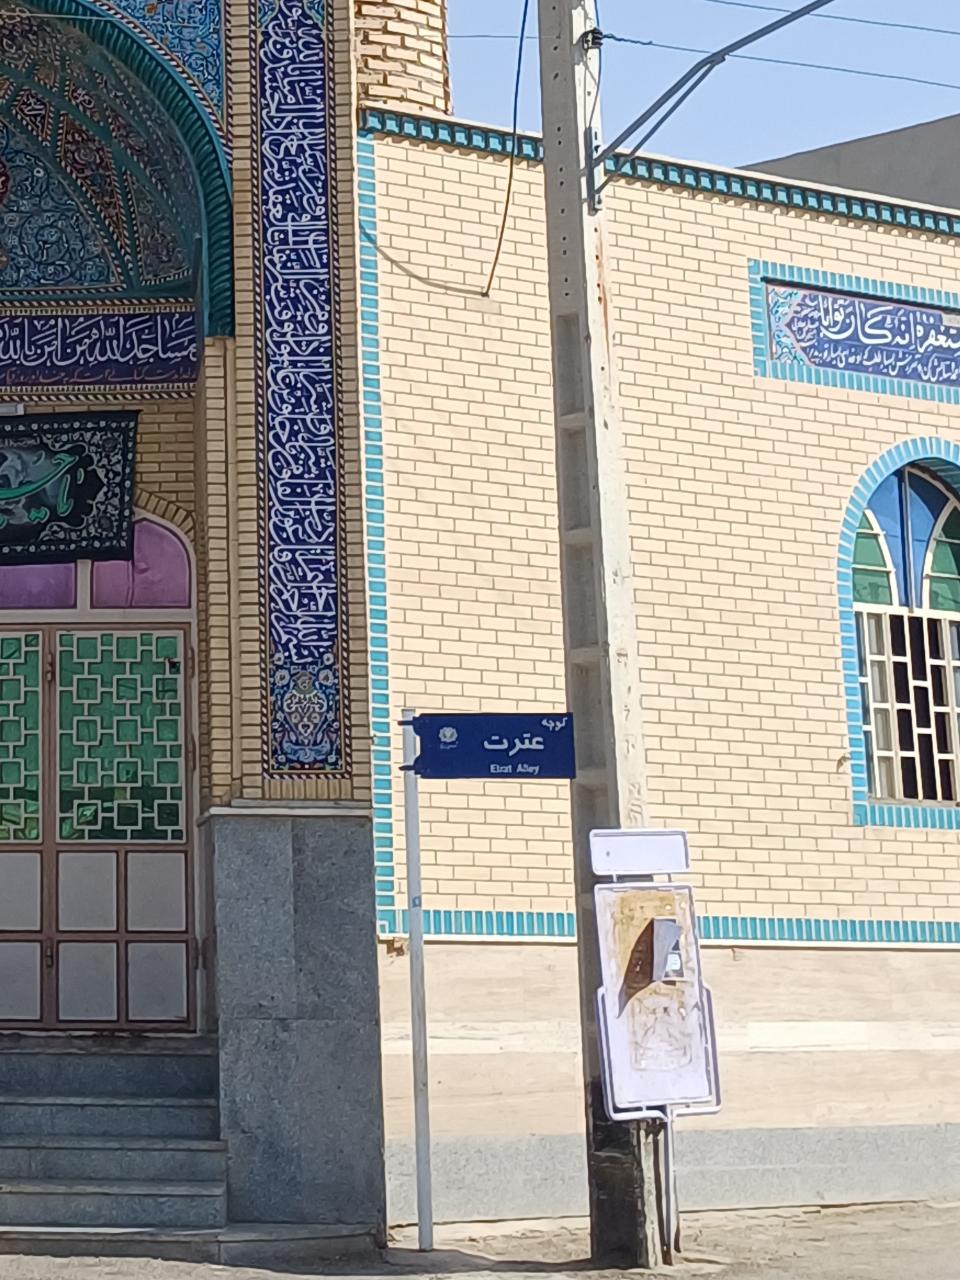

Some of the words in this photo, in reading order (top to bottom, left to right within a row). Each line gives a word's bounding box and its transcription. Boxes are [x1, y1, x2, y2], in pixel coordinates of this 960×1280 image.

[541, 717, 568, 731] کوچه
[483, 733, 545, 756] عترت
[516, 764, 540, 775] Alley
